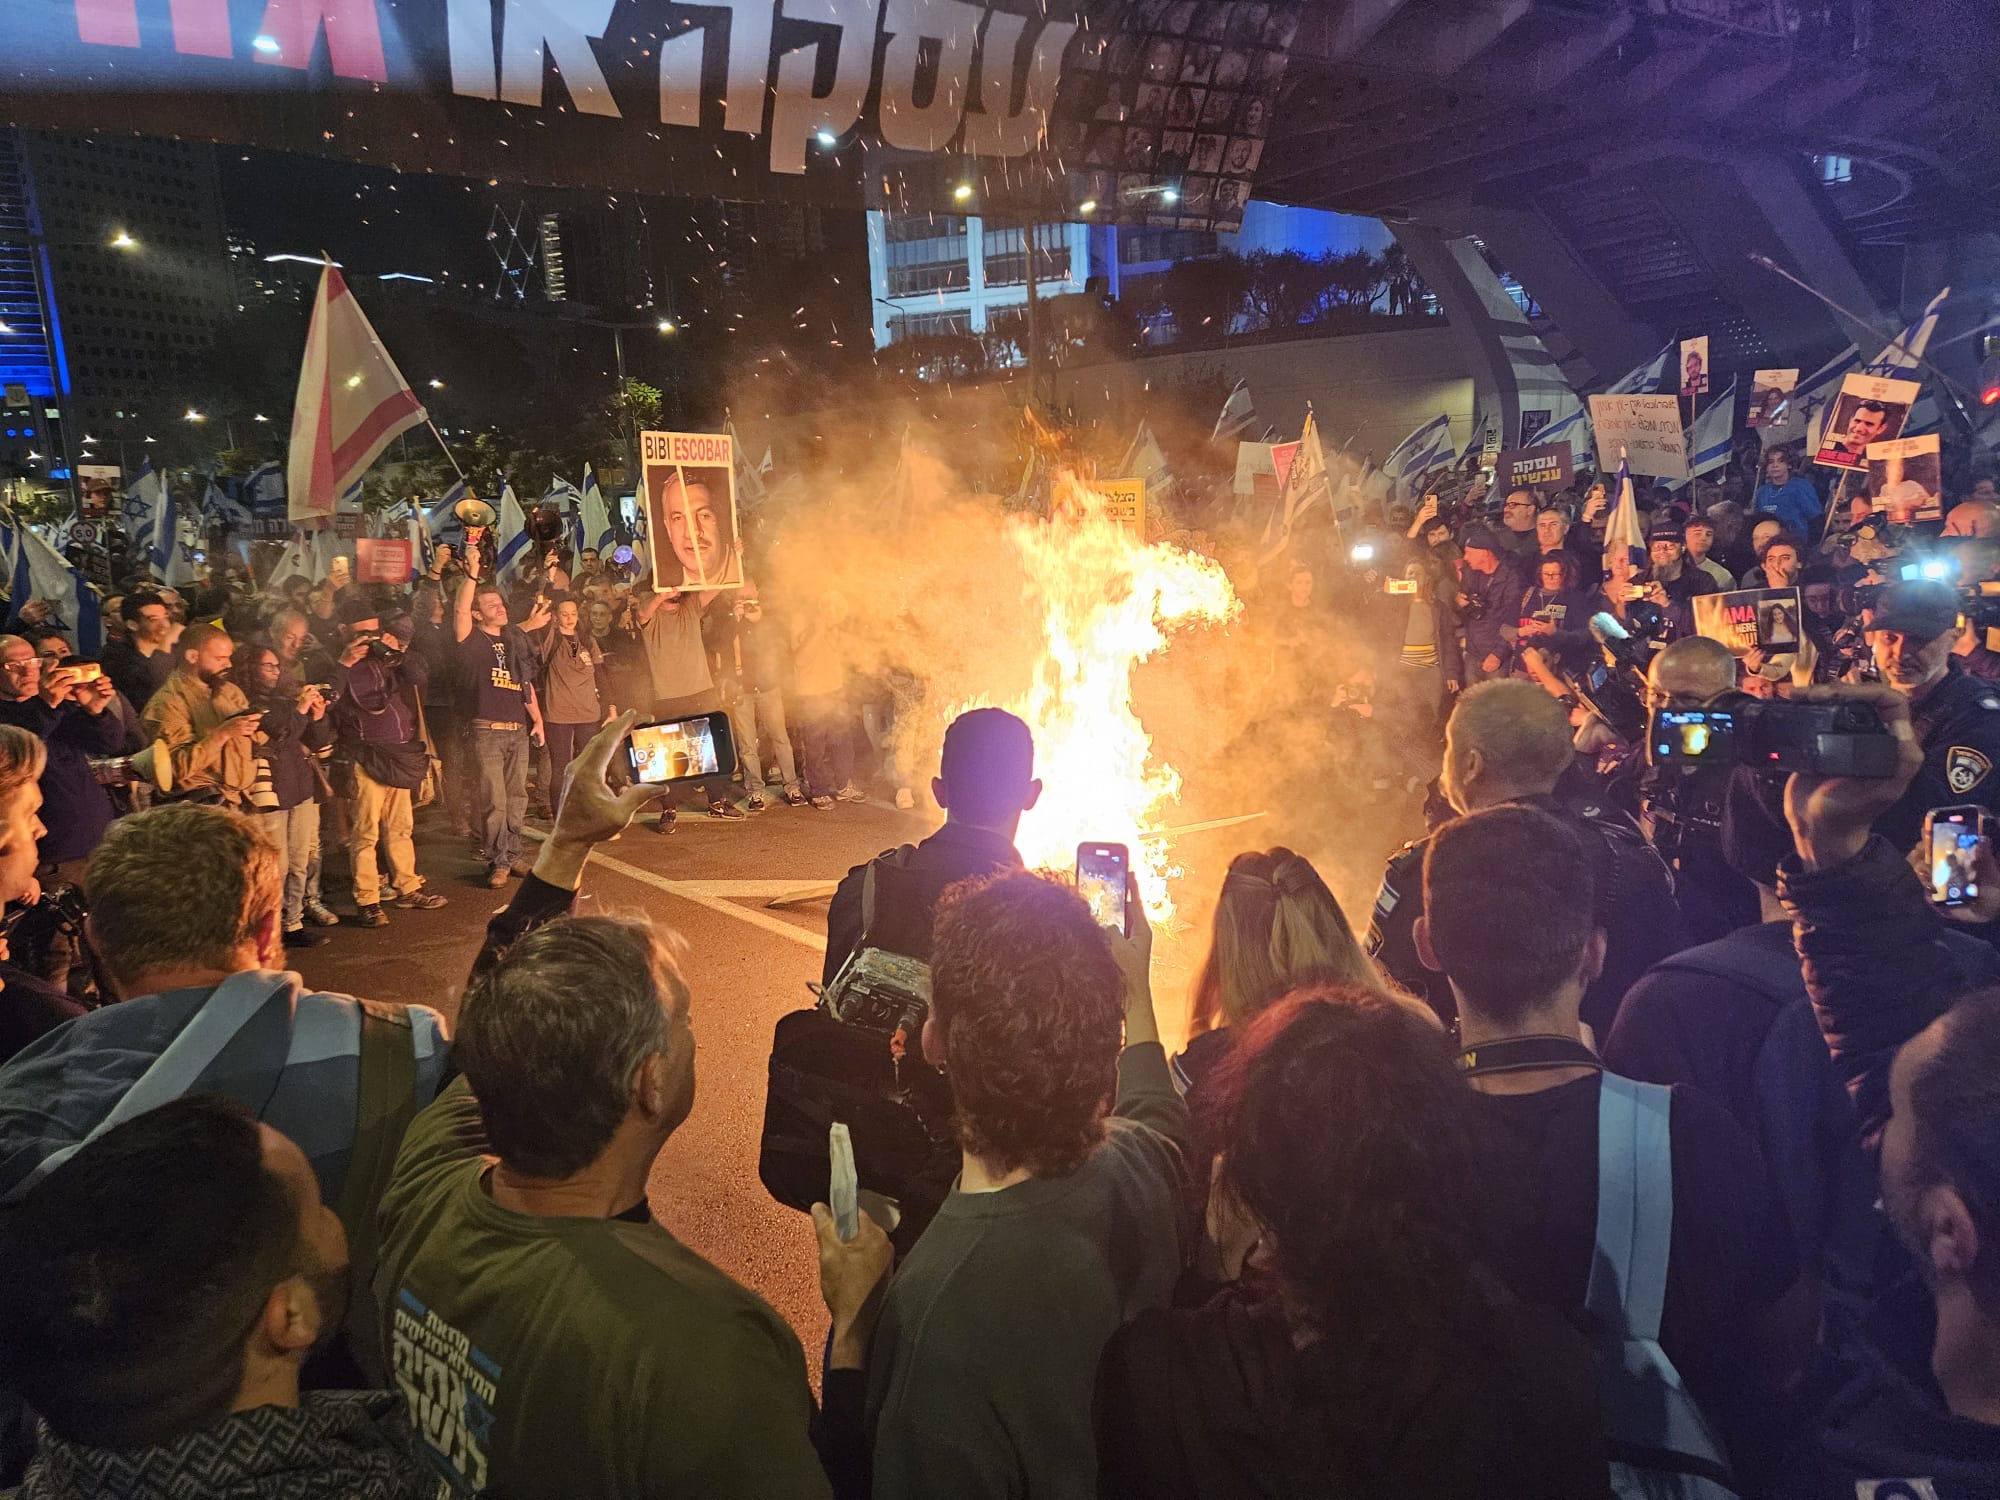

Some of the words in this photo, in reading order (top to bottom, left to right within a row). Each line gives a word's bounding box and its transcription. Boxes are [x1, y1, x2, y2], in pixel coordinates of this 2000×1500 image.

[645, 436, 671, 460] BIBI
[674, 438, 730, 462] ESCOBAR
[1513, 456, 1557, 474] עסקה
[1511, 468, 1562, 487] עכשיו!
[1722, 605, 1756, 625] AMA
[1735, 622, 1758, 633] HERE
[425, 1309, 470, 1359] מחאת
[392, 1328, 467, 1411] אחים
